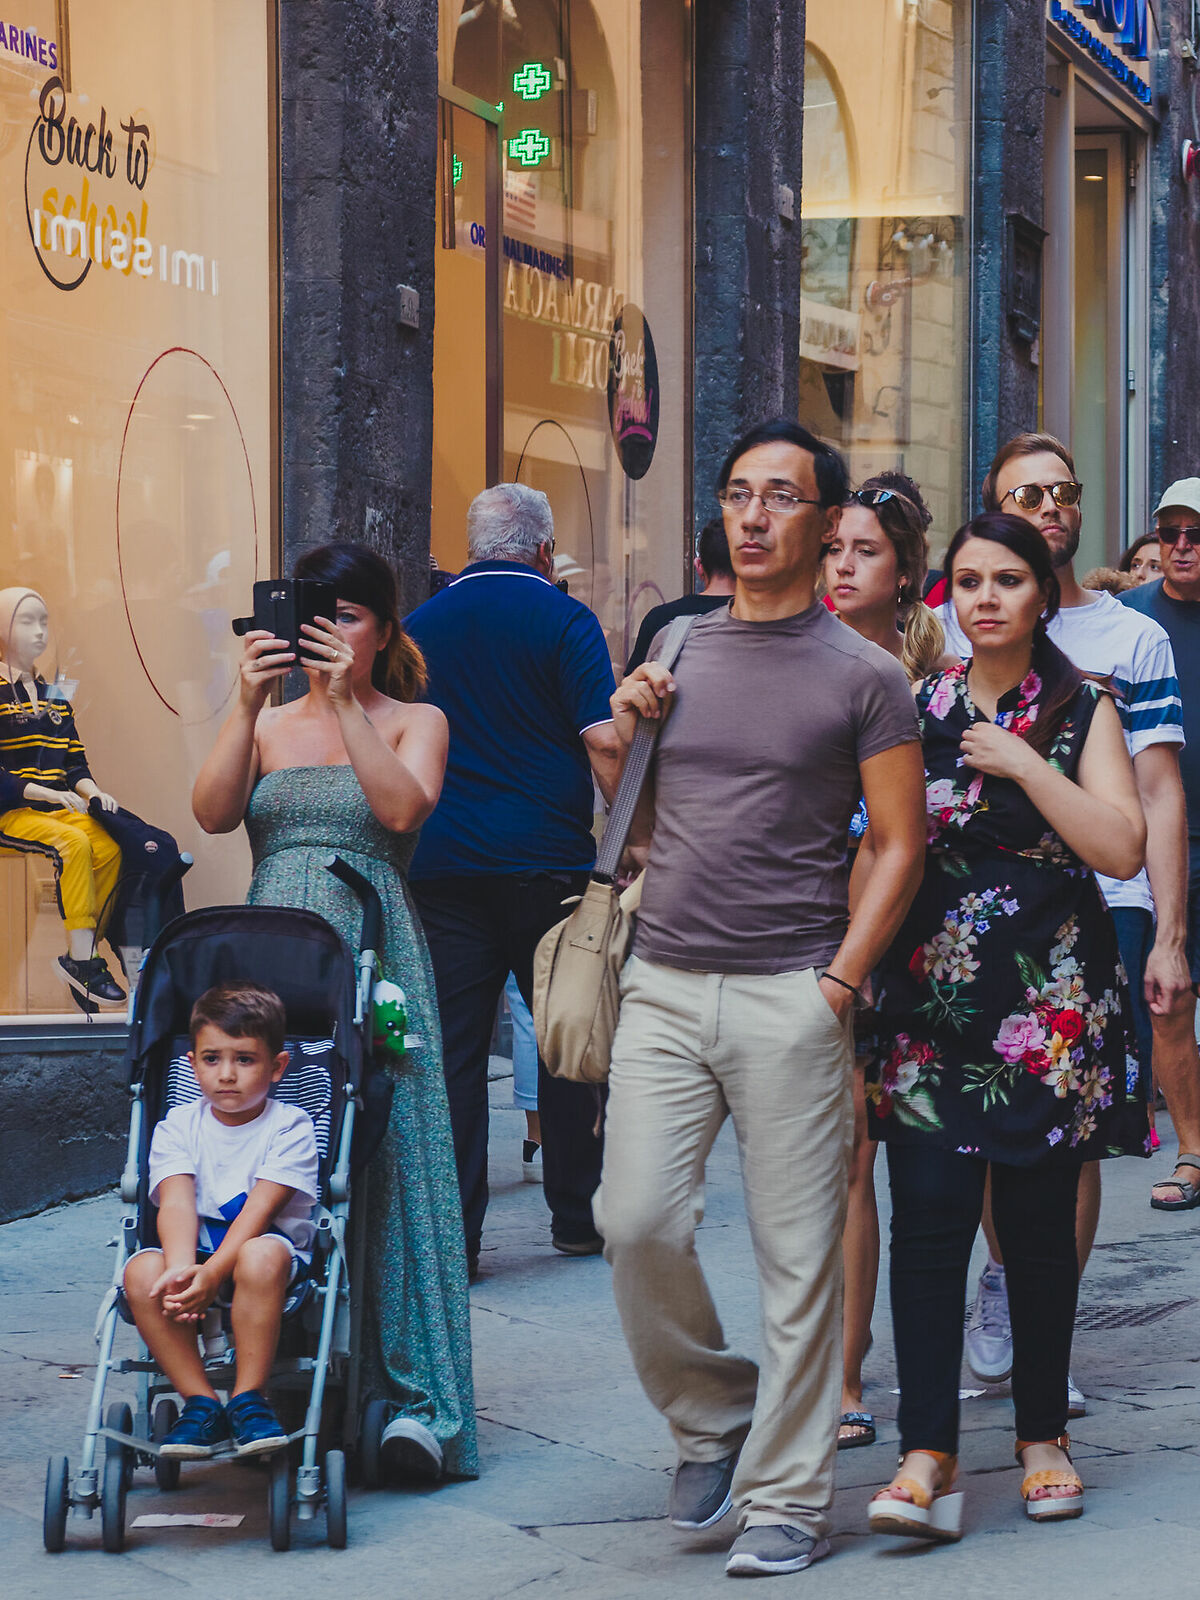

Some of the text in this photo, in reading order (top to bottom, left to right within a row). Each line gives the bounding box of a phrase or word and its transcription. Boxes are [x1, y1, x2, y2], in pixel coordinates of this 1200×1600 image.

[38, 75, 150, 191] Back to
[40, 175, 149, 279] school
